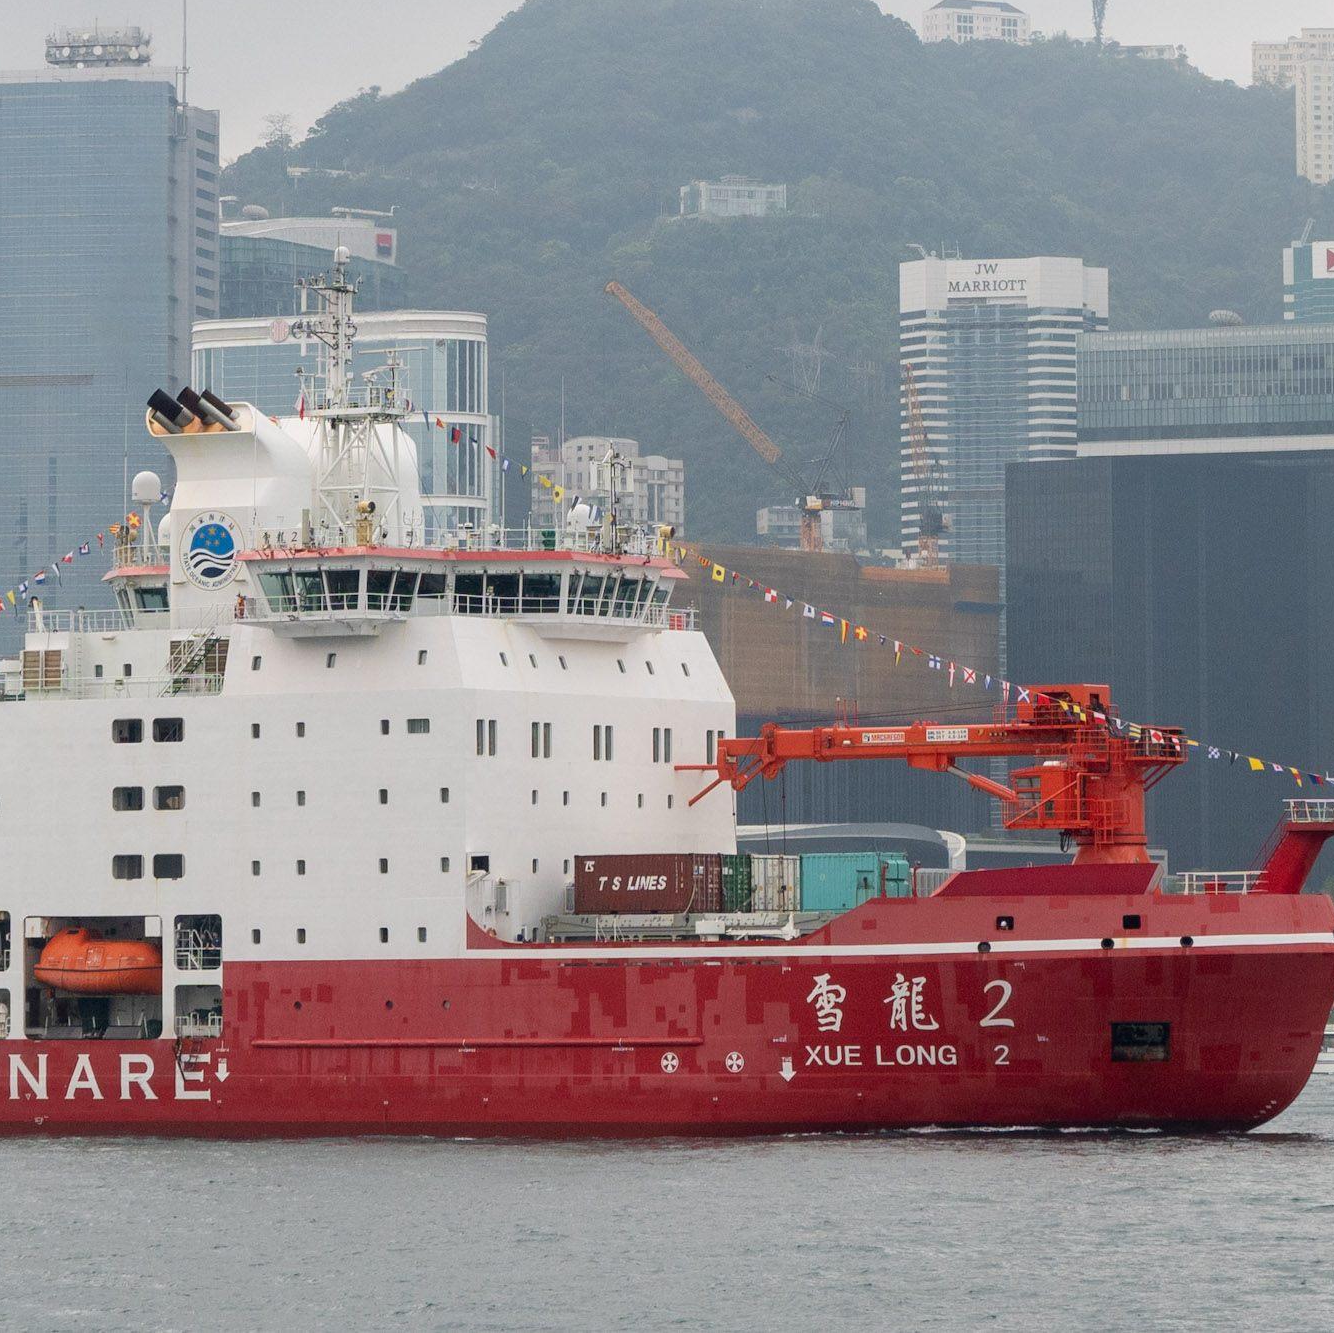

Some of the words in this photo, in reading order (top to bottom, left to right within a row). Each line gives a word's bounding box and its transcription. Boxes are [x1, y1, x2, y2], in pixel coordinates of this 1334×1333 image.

[974, 263, 999, 275] JW
[948, 279, 1027, 293] MARRIOTT
[627, 875, 667, 891] LINES
[805, 1045, 863, 1066] XUE
[875, 1045, 958, 1066] LONG
[993, 1044, 1010, 1065] 2
